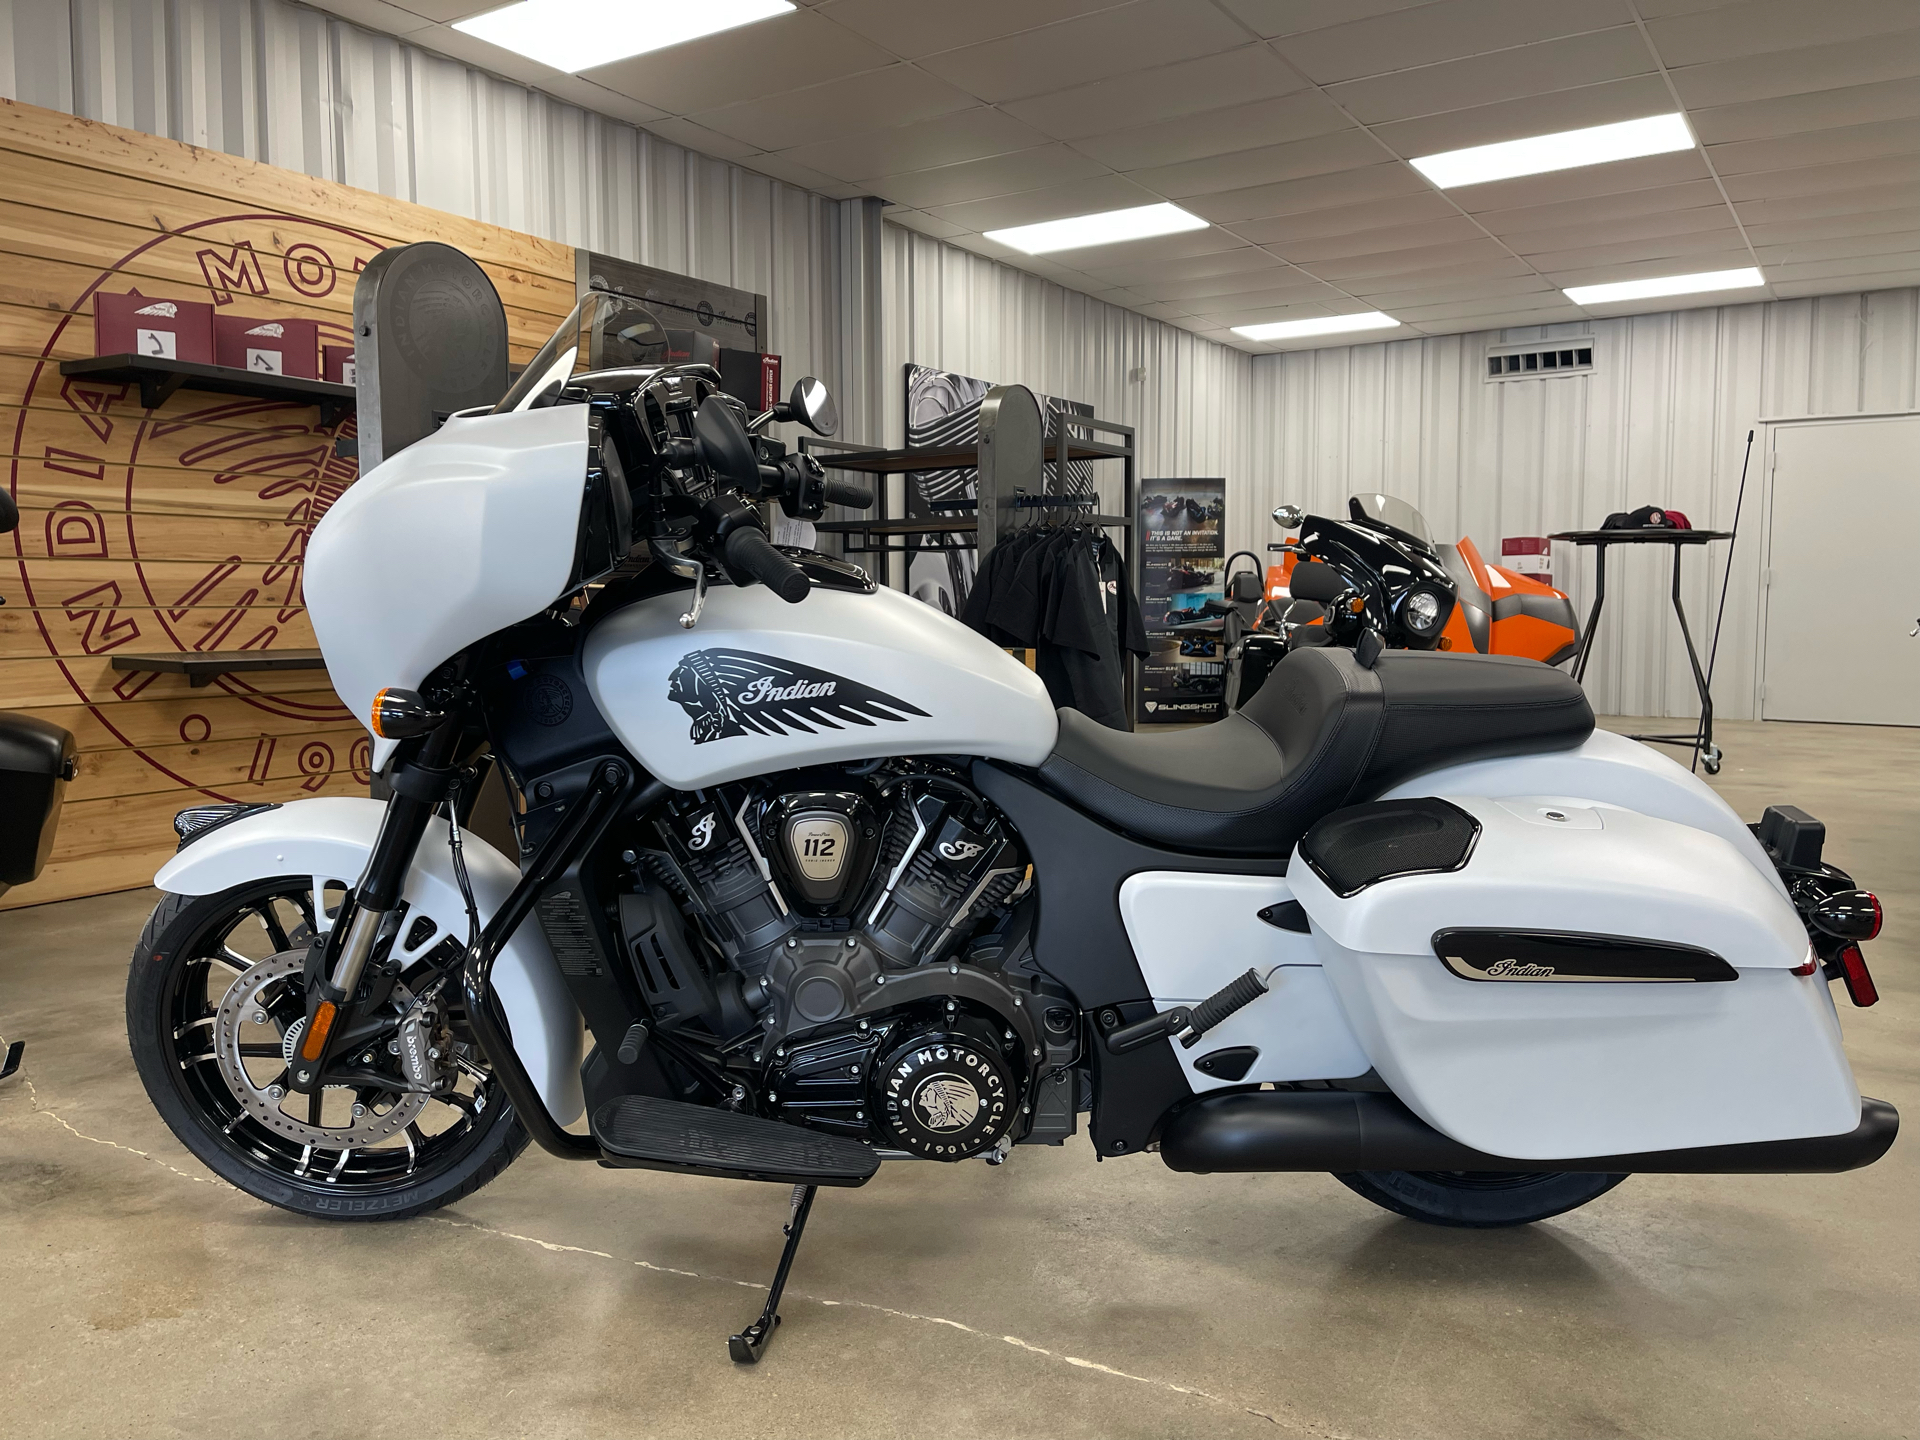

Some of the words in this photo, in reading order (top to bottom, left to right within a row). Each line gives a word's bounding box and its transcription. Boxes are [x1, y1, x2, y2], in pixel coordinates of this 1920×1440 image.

[738, 676, 836, 705] Indian
[1158, 702, 1219, 711] SLINGSHOT
[804, 838, 836, 857] 112
[1486, 958, 1555, 979] Indian
[406, 1035, 423, 1080] brembo
[886, 1062, 913, 1135] INDIAN
[917, 1047, 1004, 1136] MOTORCYCLE
[924, 1142, 968, 1154] 1901
[315, 1190, 420, 1211] METZELER
